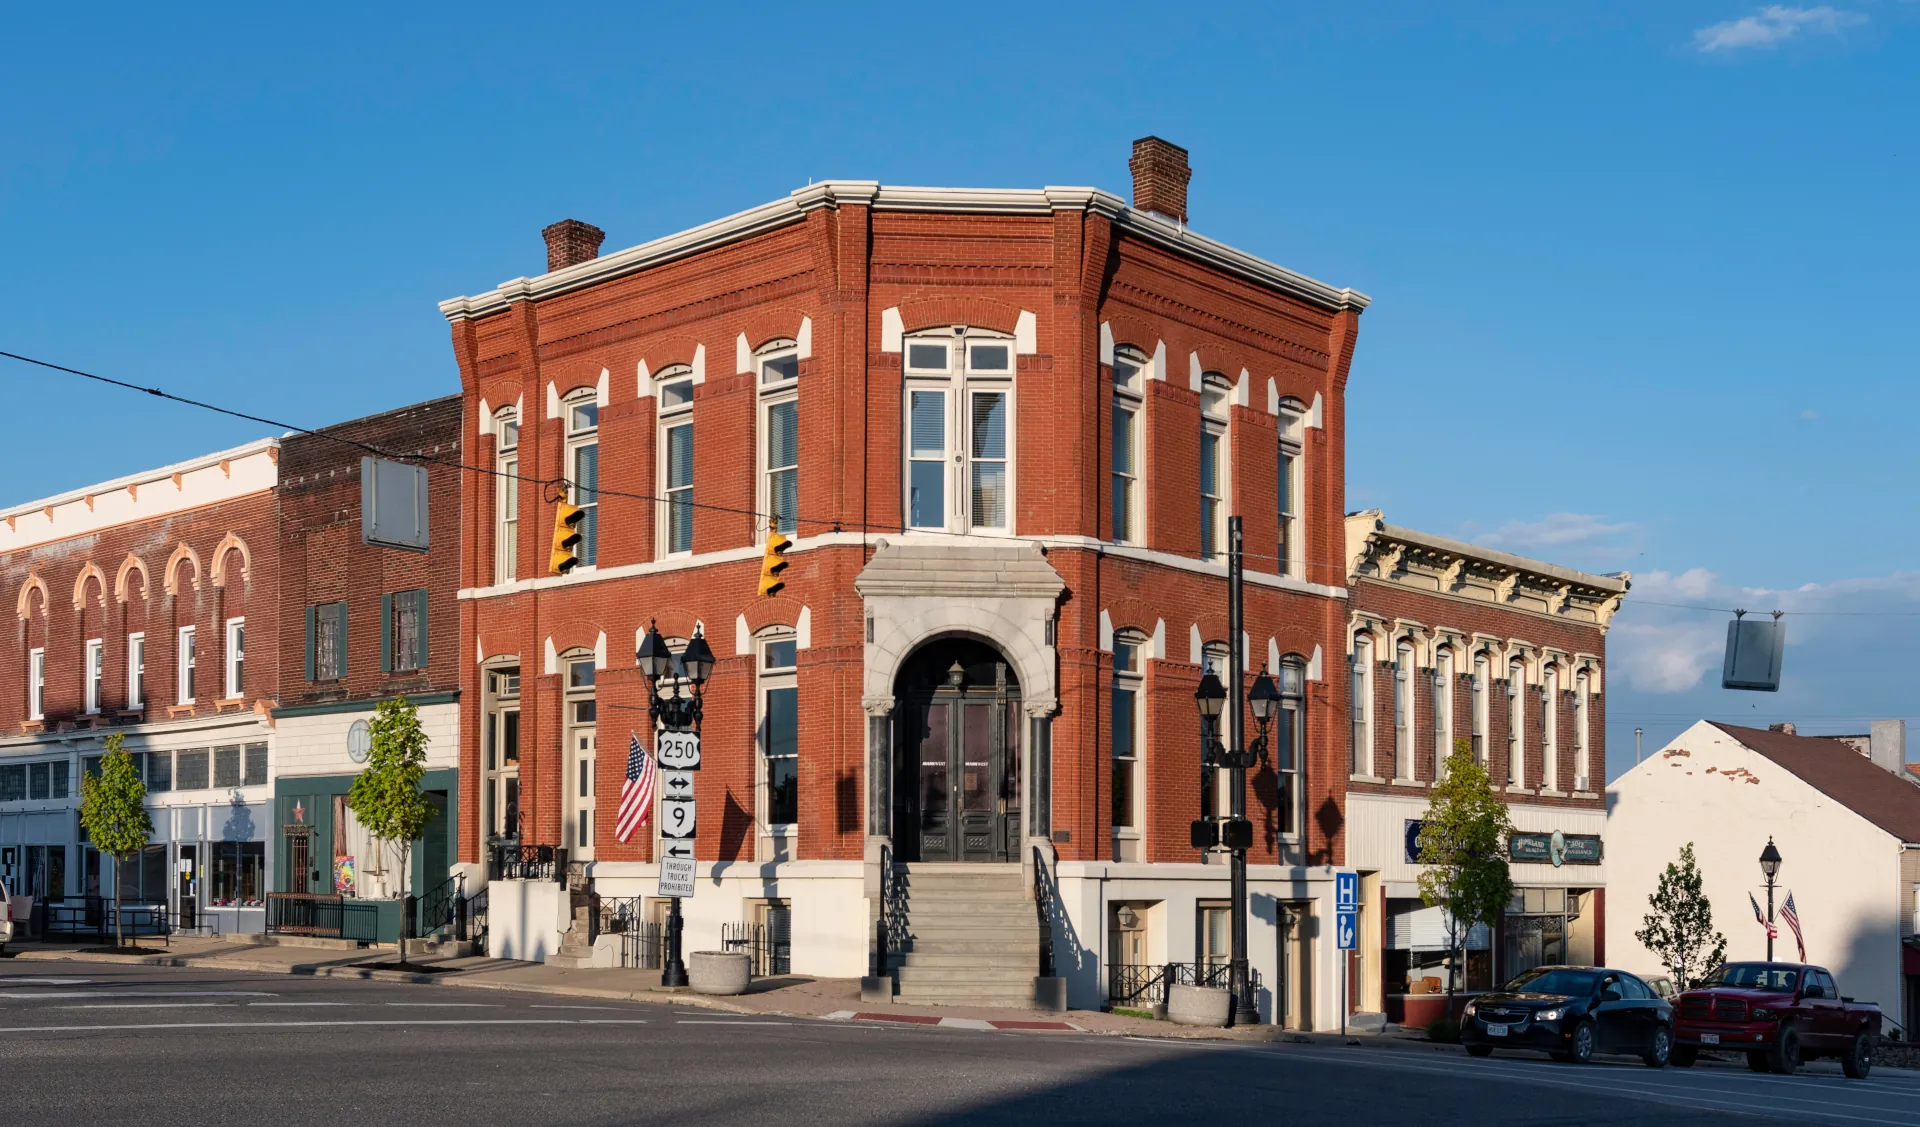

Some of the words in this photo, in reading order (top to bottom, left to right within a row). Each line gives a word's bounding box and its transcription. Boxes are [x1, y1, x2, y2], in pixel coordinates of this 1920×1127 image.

[664, 740, 694, 759] 250
[673, 807, 685, 828] 9
[666, 862, 692, 872] THROUGH
[667, 872, 689, 882] TRUCKS
[660, 882, 692, 892] PROHIBITED
[1340, 878, 1353, 903] H
